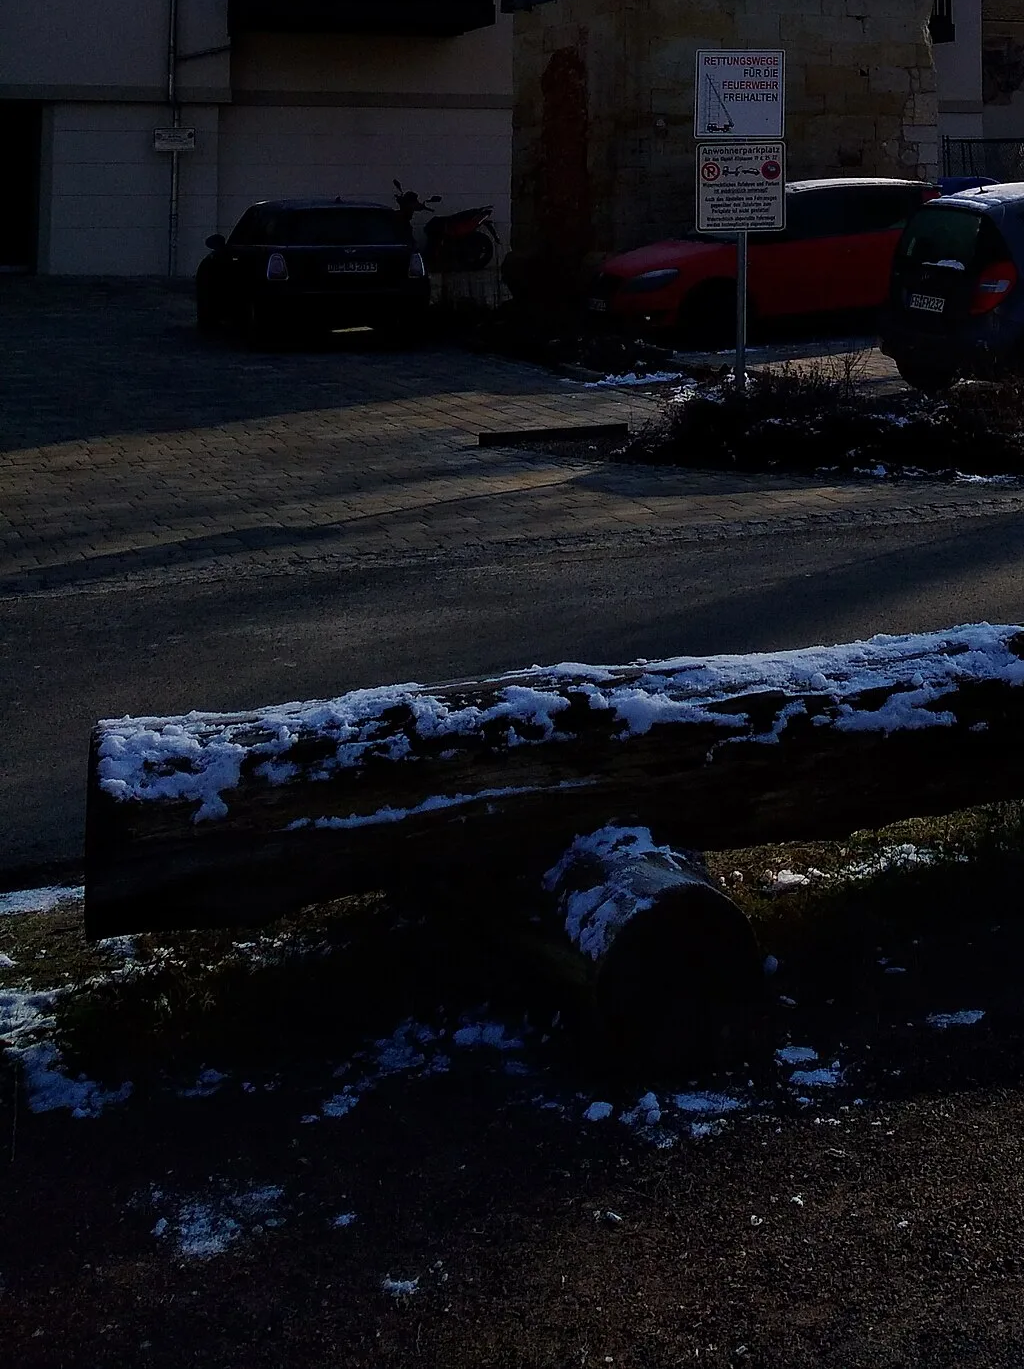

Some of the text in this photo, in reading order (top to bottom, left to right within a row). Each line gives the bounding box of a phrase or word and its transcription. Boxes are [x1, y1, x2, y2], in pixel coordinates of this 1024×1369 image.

[703, 56, 779, 65] RETTUNGSWEGE
[743, 67, 778, 78] FÜR DIE
[722, 81, 778, 90] FEUERWEHR
[723, 93, 778, 102] FREIHALTEN
[701, 146, 780, 156] Anwohnerparkplatz
